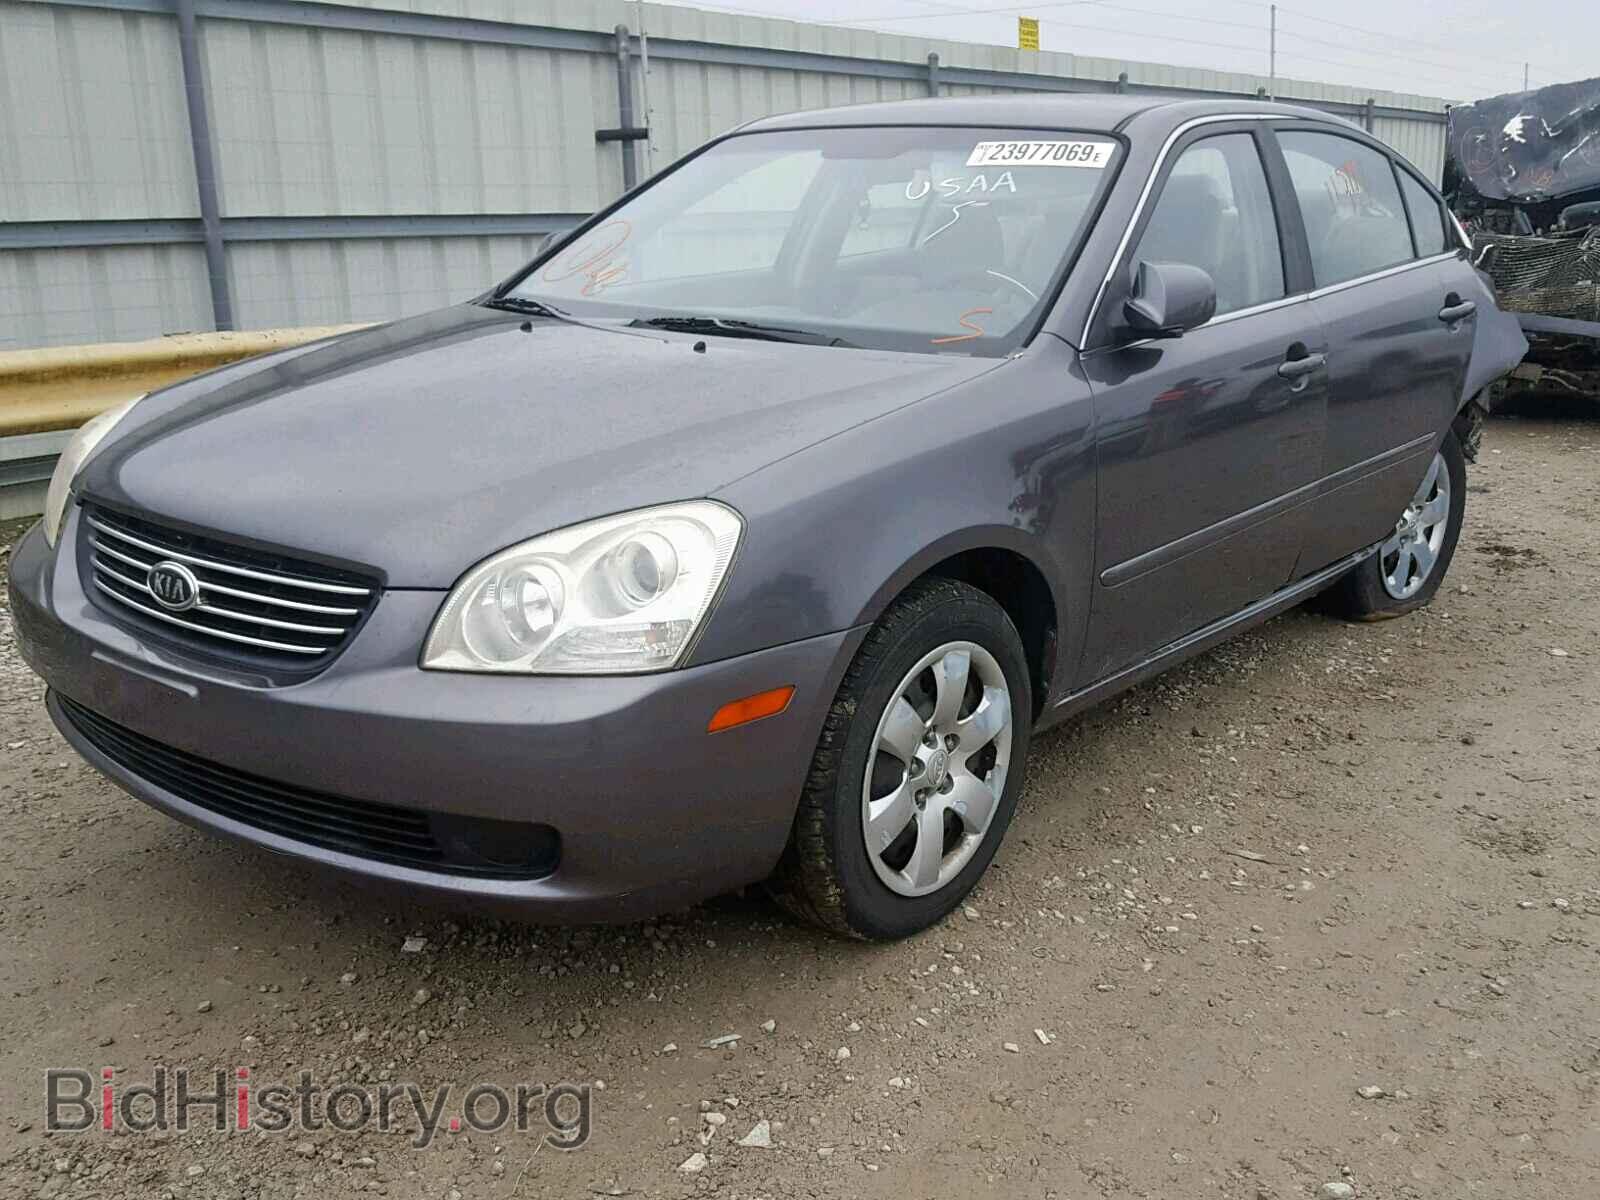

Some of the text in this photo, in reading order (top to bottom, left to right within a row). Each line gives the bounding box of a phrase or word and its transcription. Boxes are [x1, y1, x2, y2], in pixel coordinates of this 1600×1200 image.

[988, 143, 1095, 162] 23977069
[905, 171, 1017, 200] USAA
[154, 572, 185, 601] KIA
